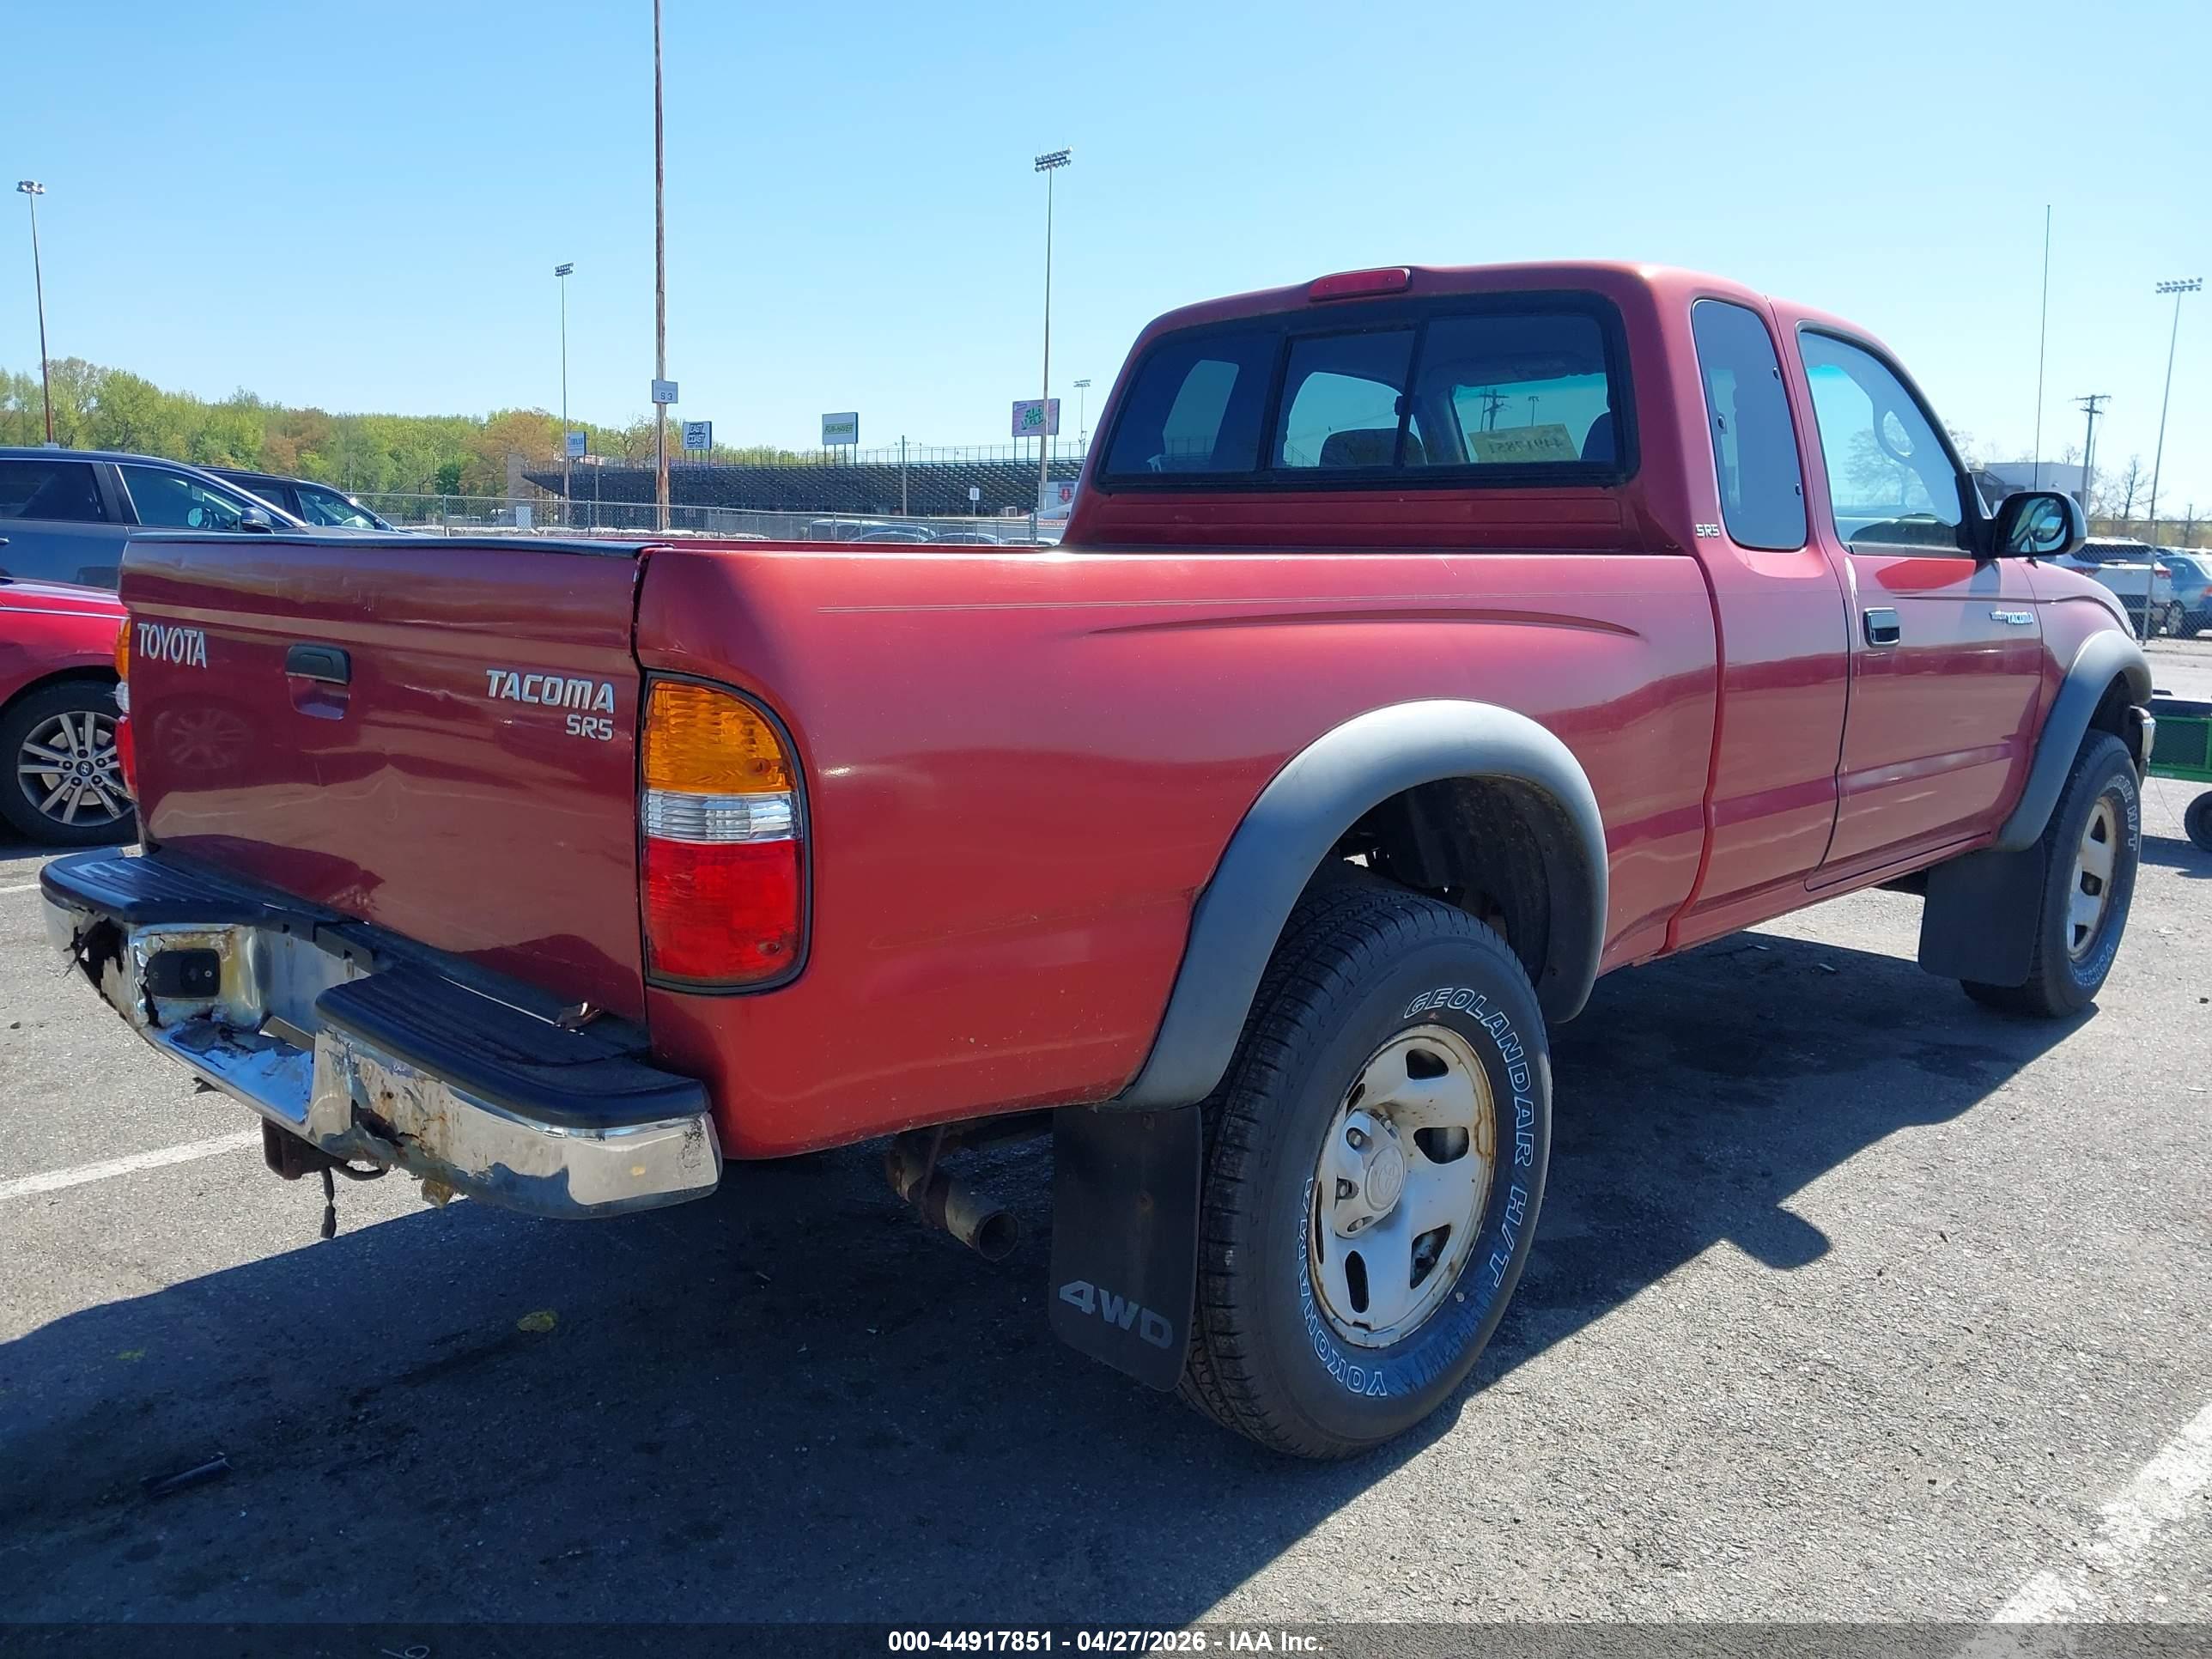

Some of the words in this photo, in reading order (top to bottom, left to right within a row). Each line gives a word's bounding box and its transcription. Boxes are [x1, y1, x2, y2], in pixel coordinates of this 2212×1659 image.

[137, 623, 207, 669] TOYOTA
[486, 669, 614, 714] TACOMA
[565, 714, 613, 741] SR5
[1403, 988, 1534, 1167] GEOLANDAR
[1489, 1185, 1528, 1289] H/T
[1058, 1279, 1174, 1349] 4WD
[1297, 1176, 1388, 1397] YOKOHAMA
